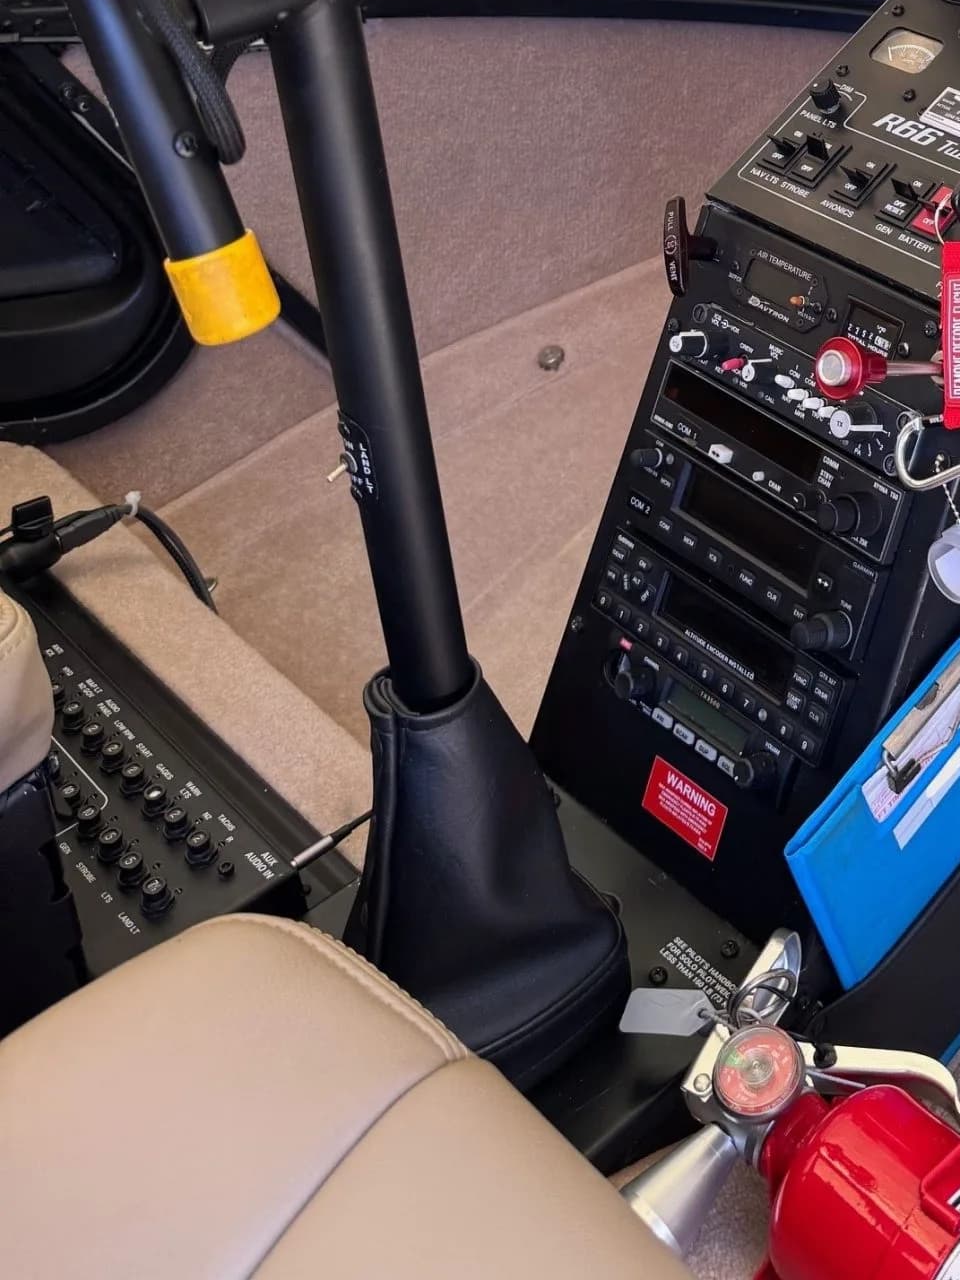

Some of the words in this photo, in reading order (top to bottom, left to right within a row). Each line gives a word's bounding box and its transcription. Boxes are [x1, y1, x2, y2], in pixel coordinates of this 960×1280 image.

[800, 109, 822, 123] PANEL
[822, 119, 837, 129] LTS
[872, 112, 944, 146] R66
[771, 152, 784, 160] OFF
[800, 164, 814, 172] OFF
[750, 167, 766, 180] NAV
[765, 175, 780, 185] LTS
[780, 181, 810, 198] STROBE
[844, 182, 857, 191] OFF
[912, 180, 923, 188] ON
[820, 199, 855, 218] AVIONICS
[875, 223, 893, 236] GEN
[898, 234, 935, 254] BATTERY
[669, 260, 678, 281] VENT
[757, 250, 769, 260] AIR
[769, 254, 813, 282] TEMPERATURE
[739, 342, 754, 354] CREW
[847, 332, 866, 347] TOTAL
[867, 343, 889, 358] HOURS
[677, 422, 692, 436] COM
[359, 442, 372, 475] LAND
[822, 455, 840, 470] COMM
[365, 477, 374, 494] LT
[768, 480, 782, 493] CHAN
[817, 476, 832, 489] CHAN
[630, 496, 645, 510] COM
[644, 506, 651, 514] 2
[659, 520, 671, 531] COM
[852, 561, 875, 578] GARMIN
[739, 572, 753, 586] FUNC
[641, 589, 650, 602] OFF
[766, 591, 778, 602] CLR
[684, 629, 706, 649] ALTITUDE
[706, 642, 730, 664] ENCODER
[727, 659, 755, 681] INSTALLED
[793, 672, 808, 686] FUNC
[722, 684, 729, 694] 6
[787, 691, 801, 703] START
[743, 699, 750, 708] 7
[808, 711, 821, 723] CLR
[114, 719, 127, 732] LOW
[122, 728, 136, 741] RPM
[135, 742, 154, 759] START
[156, 763, 175, 781] GAGES
[180, 787, 192, 799] LTS
[185, 781, 202, 797] WARN
[667, 770, 717, 817] WARNING
[218, 813, 236, 832] TACHS
[59, 841, 73, 856] GEN
[124, 856, 137, 866] 5
[244, 851, 267, 873] AUDIO
[262, 870, 275, 880] IN
[260, 851, 278, 867] AUX
[75, 862, 97, 884] STROBE
[100, 891, 114, 904] LTS
[117, 911, 134, 931] LAND
[128, 924, 142, 936] LT
[673, 936, 688, 950] SEE
[685, 947, 711, 970] PILOT'S
[659, 947, 678, 965] LESS
[675, 961, 694, 979] THAN
[692, 976, 705, 988] 160
[702, 985, 714, 996] LB
[666, 942, 682, 956] FOR
[679, 953, 698, 971] SOLO
[695, 968, 717, 986] PILOT
